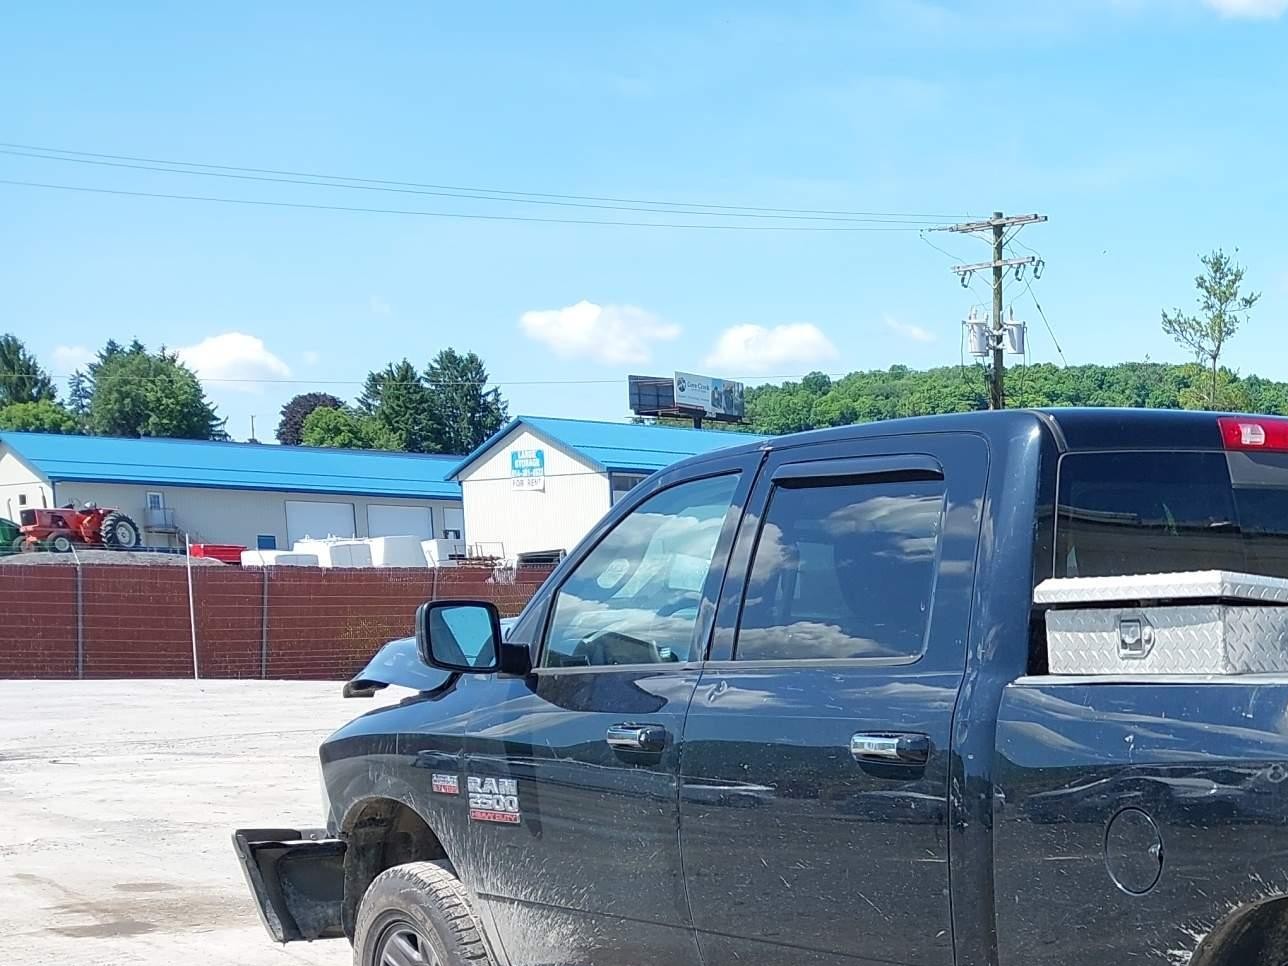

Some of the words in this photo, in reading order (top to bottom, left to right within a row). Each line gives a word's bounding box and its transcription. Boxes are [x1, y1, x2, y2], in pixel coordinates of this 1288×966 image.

[512, 479, 524, 488] FOR
[527, 478, 542, 487] RENT
[467, 776, 518, 796] RAM
[469, 793, 519, 813] 2500
